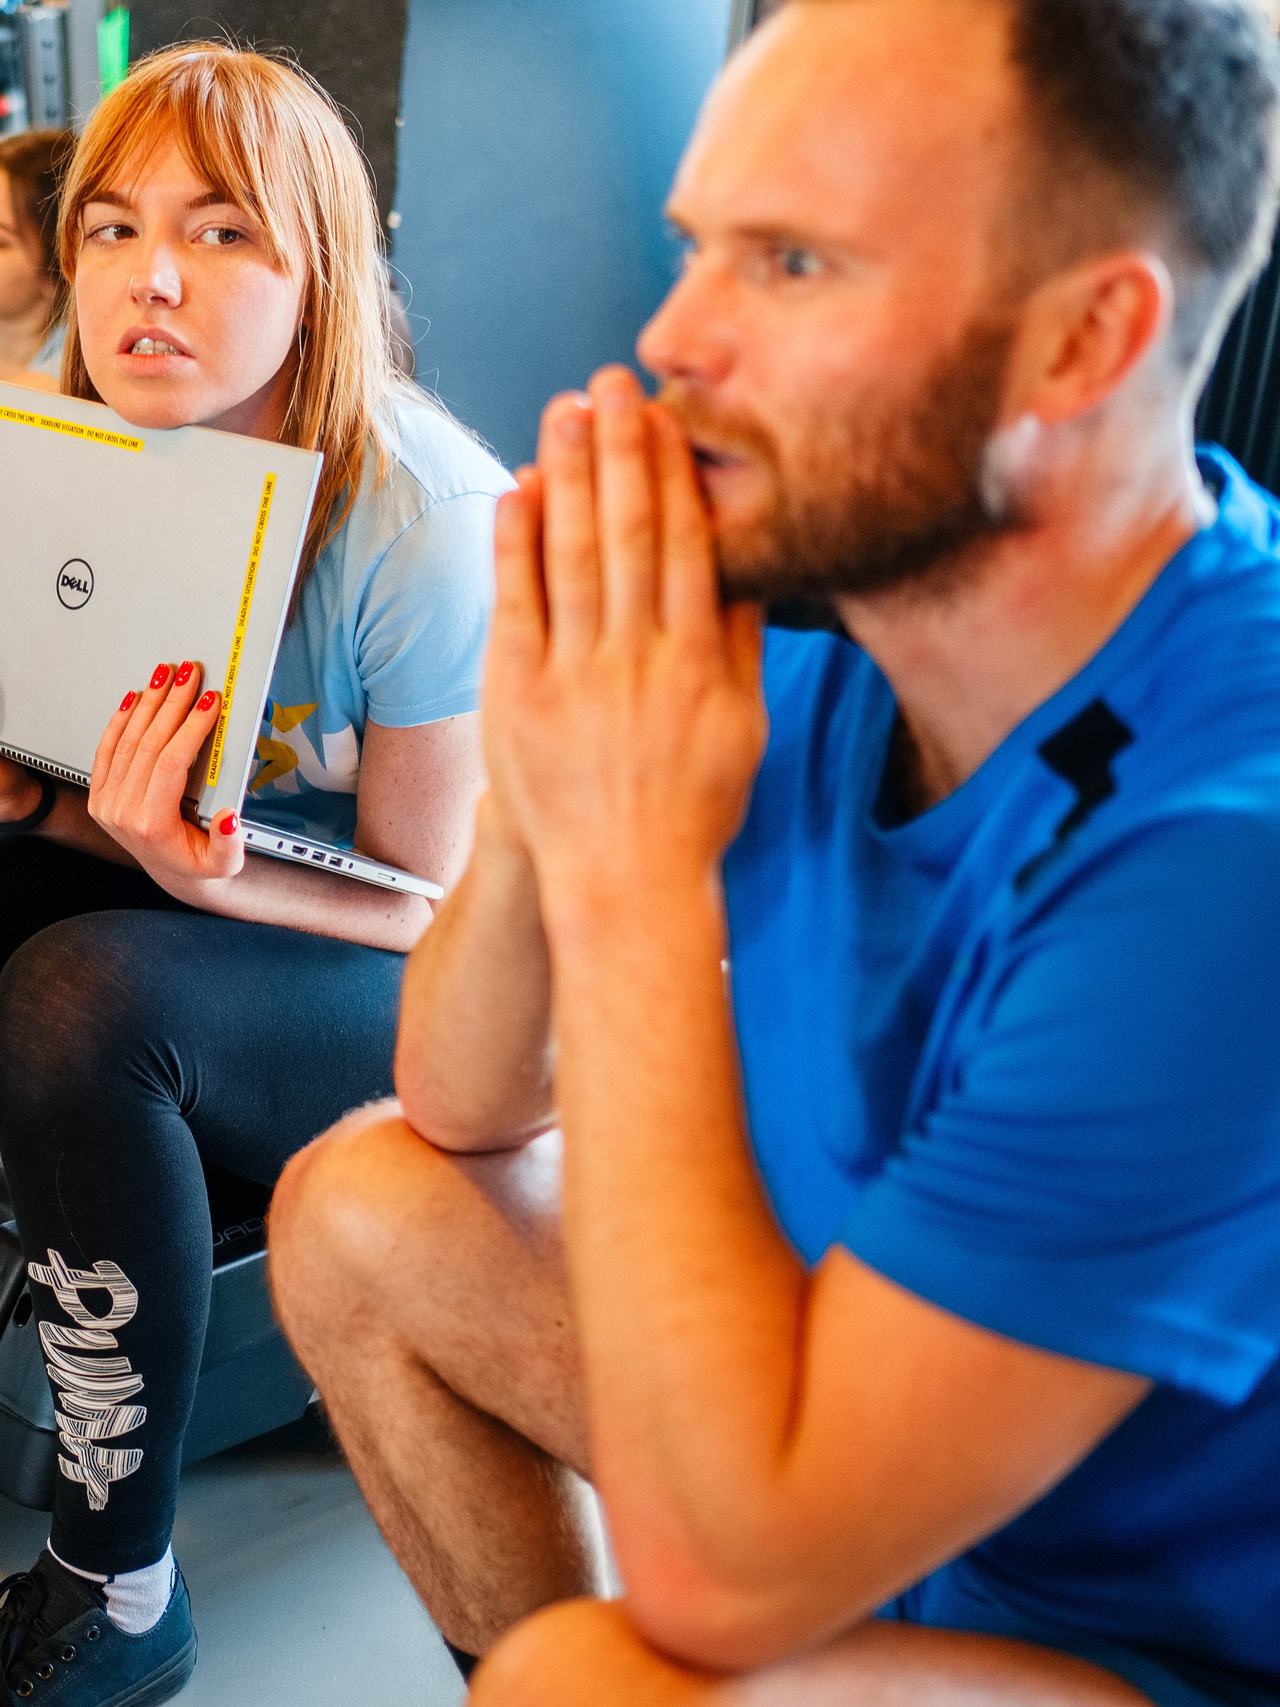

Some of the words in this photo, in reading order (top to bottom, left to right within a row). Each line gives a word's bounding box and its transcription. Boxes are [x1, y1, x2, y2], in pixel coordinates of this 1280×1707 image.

[4, 410, 17, 418] CROSS
[26, 415, 35, 423] LINE
[41, 419, 61, 429] DEADLINE
[61, 424, 84, 434] SITUATION
[104, 434, 119, 443] CROSS
[128, 440, 139, 448] LINE
[60, 574, 89, 594] DELL
[210, 749, 220, 779] DEADLINE
[216, 714, 226, 748] SITUATION
[228, 664, 236, 684] CROSS
[239, 596, 249, 626] DEADLINE
[245, 561, 256, 594] SITUATION
[258, 509, 267, 529] CROSS
[28, 1248, 147, 1511] PUMA
